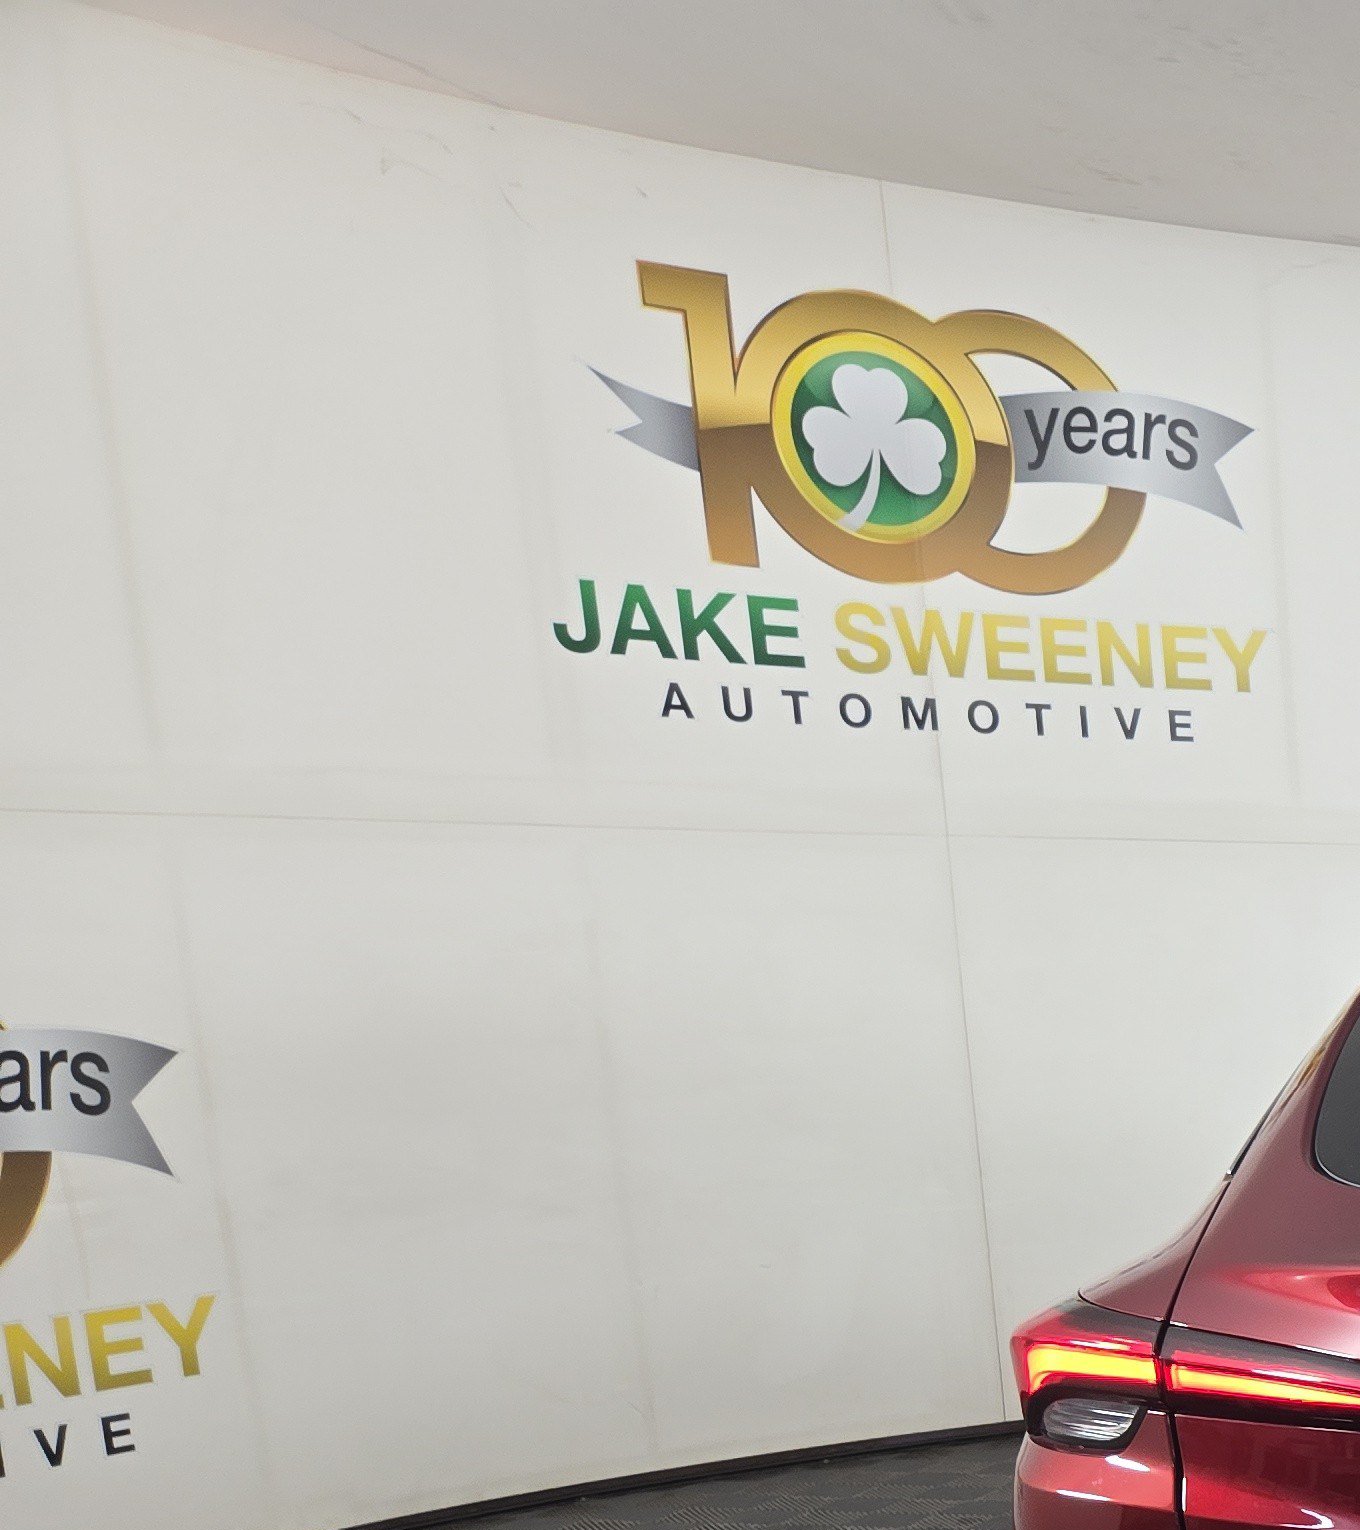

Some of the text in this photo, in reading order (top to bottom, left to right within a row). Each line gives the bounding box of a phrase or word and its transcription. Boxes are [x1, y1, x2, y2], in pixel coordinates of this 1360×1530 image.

[1024, 406, 1200, 471] years
[553, 579, 1268, 693] JAKE SWEENEY
[661, 682, 1195, 742] AUTOMOTIVE
[0, 1294, 217, 1410] NEY
